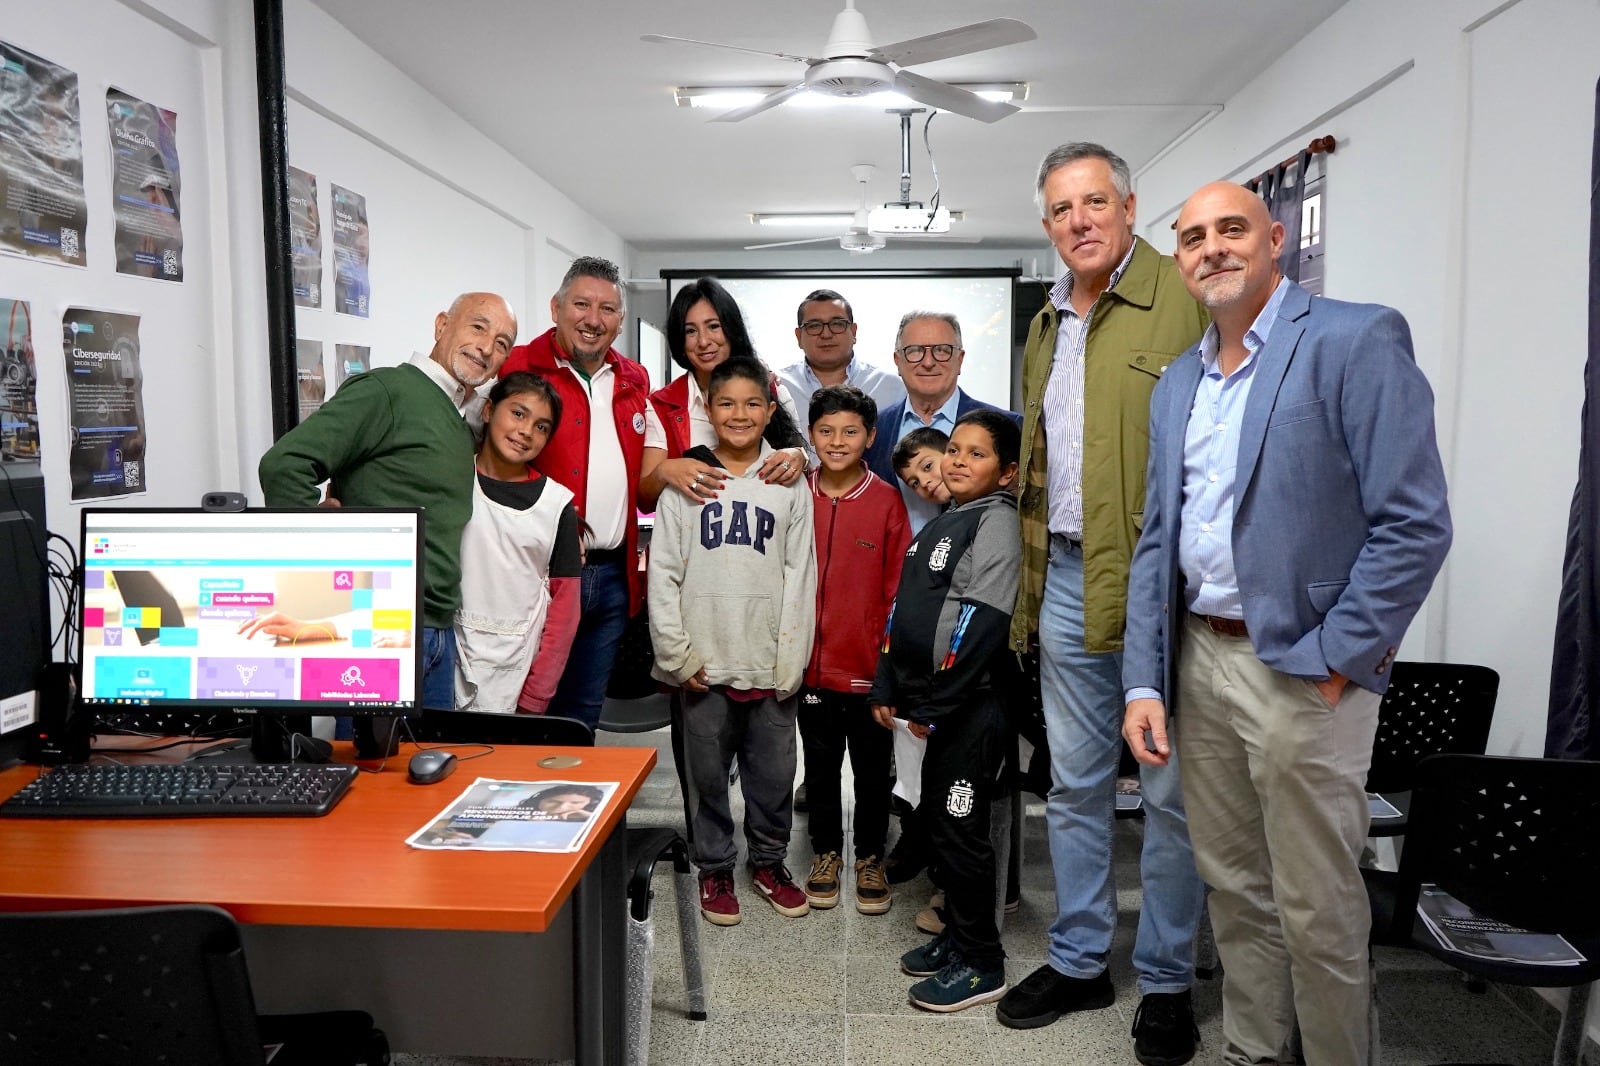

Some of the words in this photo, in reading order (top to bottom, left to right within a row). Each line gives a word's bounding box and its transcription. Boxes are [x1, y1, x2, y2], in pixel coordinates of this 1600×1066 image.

[134, 134, 155, 148] Gráfico
[73, 348, 121, 361] Ciberseguridad
[700, 500, 776, 555] GAP
